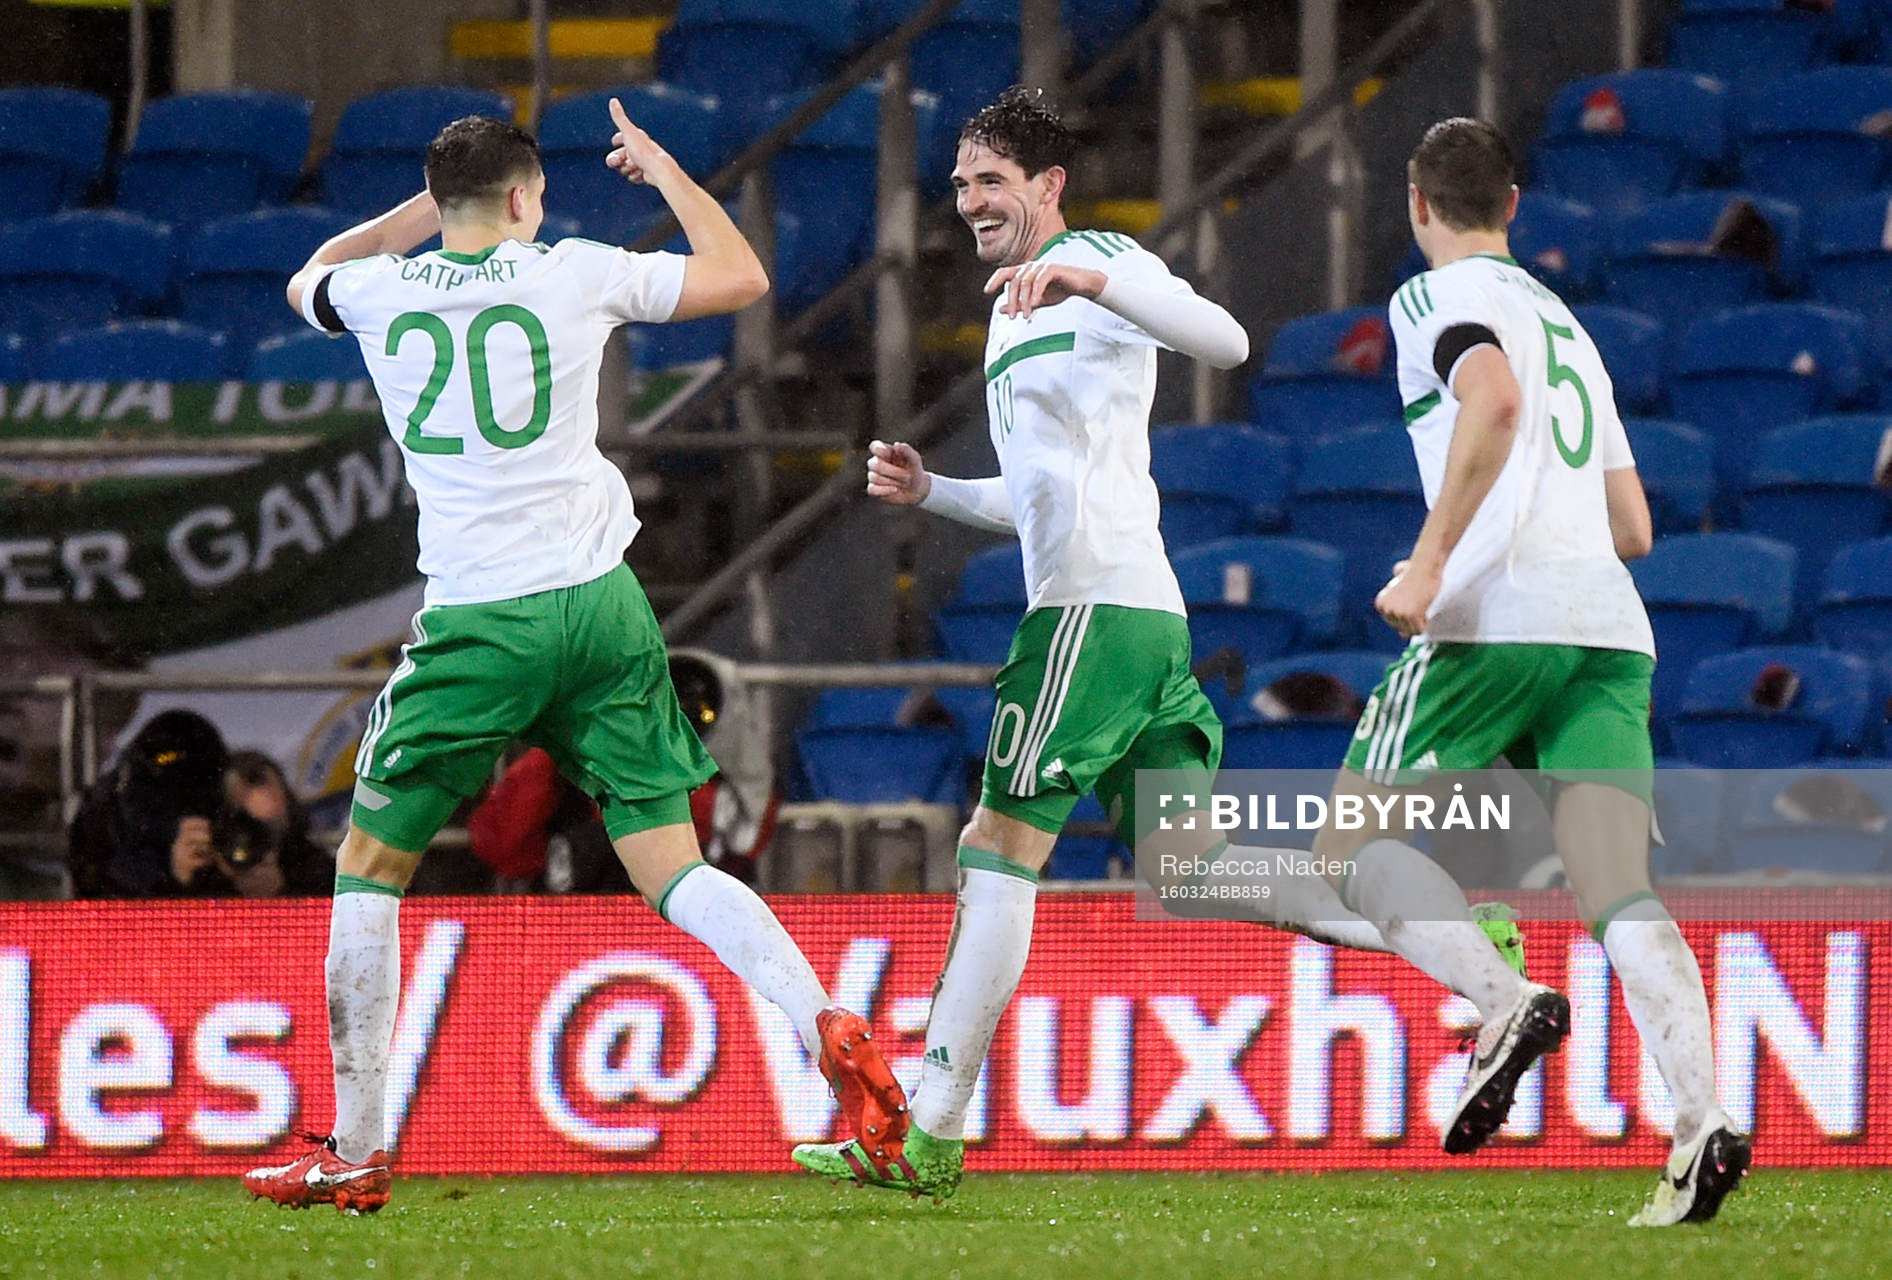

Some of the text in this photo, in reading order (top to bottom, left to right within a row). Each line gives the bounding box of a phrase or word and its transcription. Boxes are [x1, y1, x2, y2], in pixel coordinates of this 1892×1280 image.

[401, 258, 518, 291] CATHART
[0, 380, 172, 423] MA
[385, 304, 552, 455] 20
[994, 372, 1014, 444] 10
[1536, 311, 1594, 469] 5
[167, 440, 410, 587] GAW
